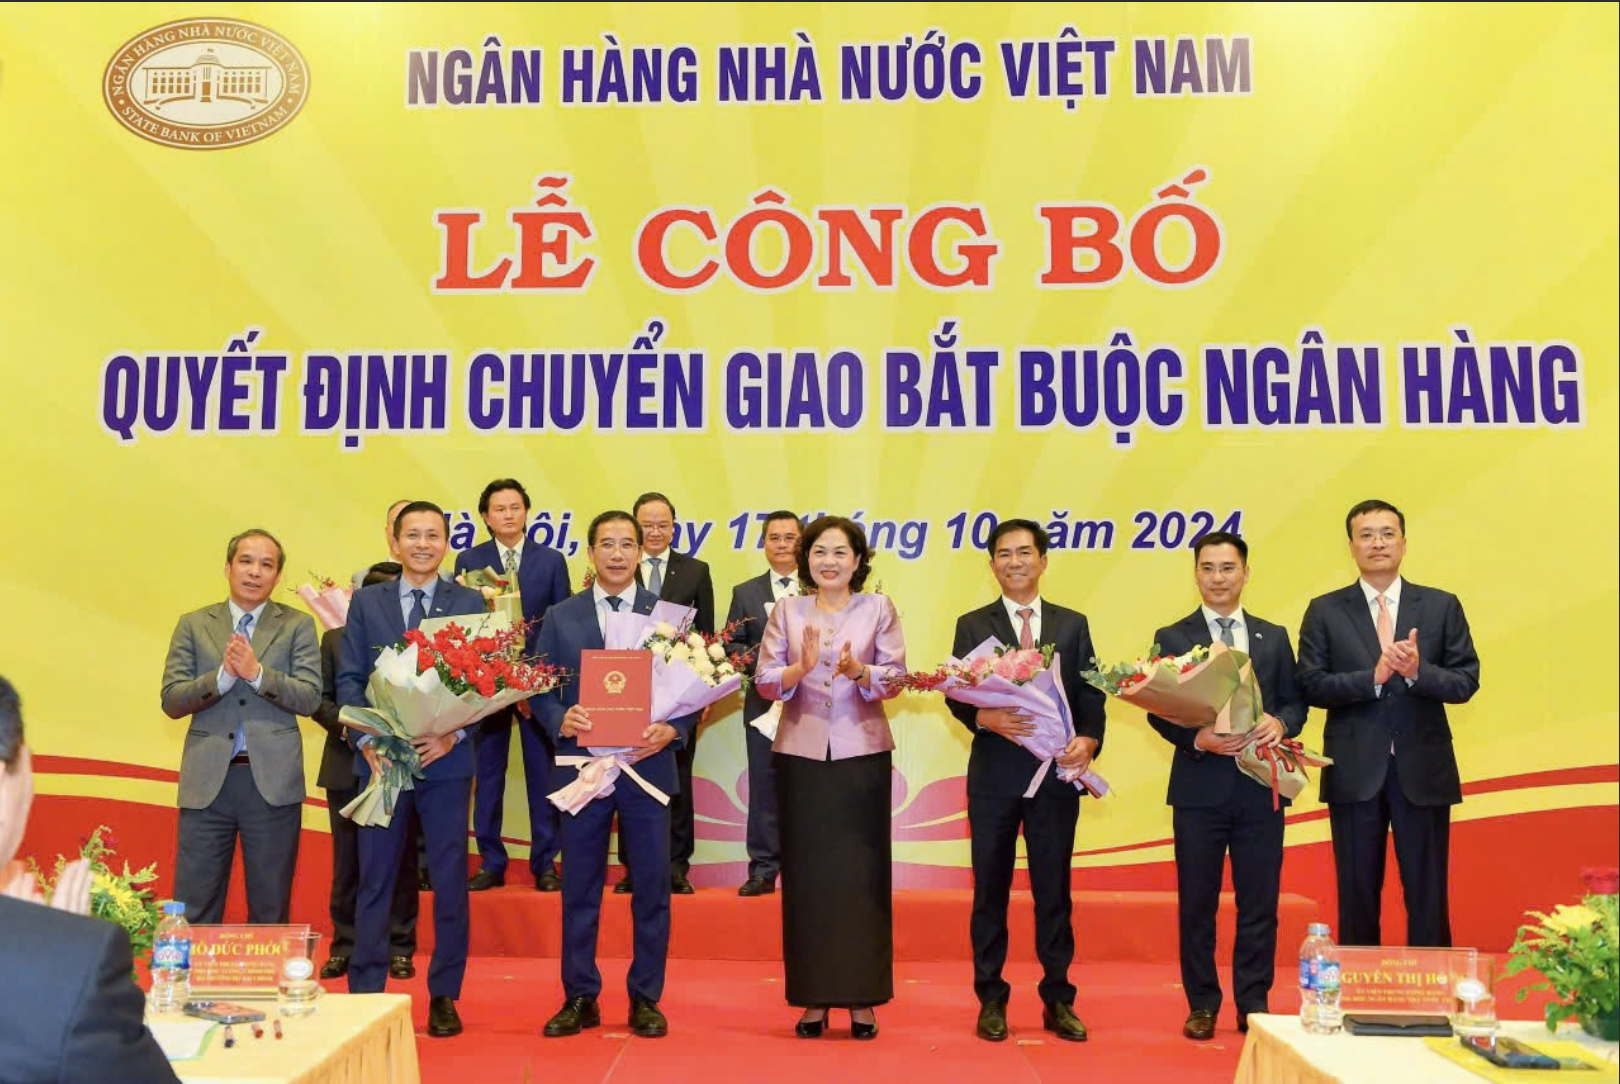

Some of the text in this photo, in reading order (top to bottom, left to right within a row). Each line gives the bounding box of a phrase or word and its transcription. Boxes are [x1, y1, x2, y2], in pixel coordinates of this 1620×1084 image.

[112, 54, 137, 97] NGÂN
[135, 29, 177, 57] HÀNG
[178, 25, 211, 40] NHÀ
[285, 60, 303, 95] NAM
[407, 27, 1252, 109] NGÂN HÀNG NHÀ NƯỚC VIỆT NAM
[121, 106, 291, 143] STATE BANK OF VIETNAM
[435, 169, 1221, 289] LỄ CÔNG BỐ
[102, 320, 1580, 448] QUYẾT ĐỊNH CHUYỂN GIAO BẮT BUỘC NGÂN HÀNG
[443, 512, 476, 550] à
[946, 511, 998, 549] 10
[1046, 510, 1115, 549] ăm
